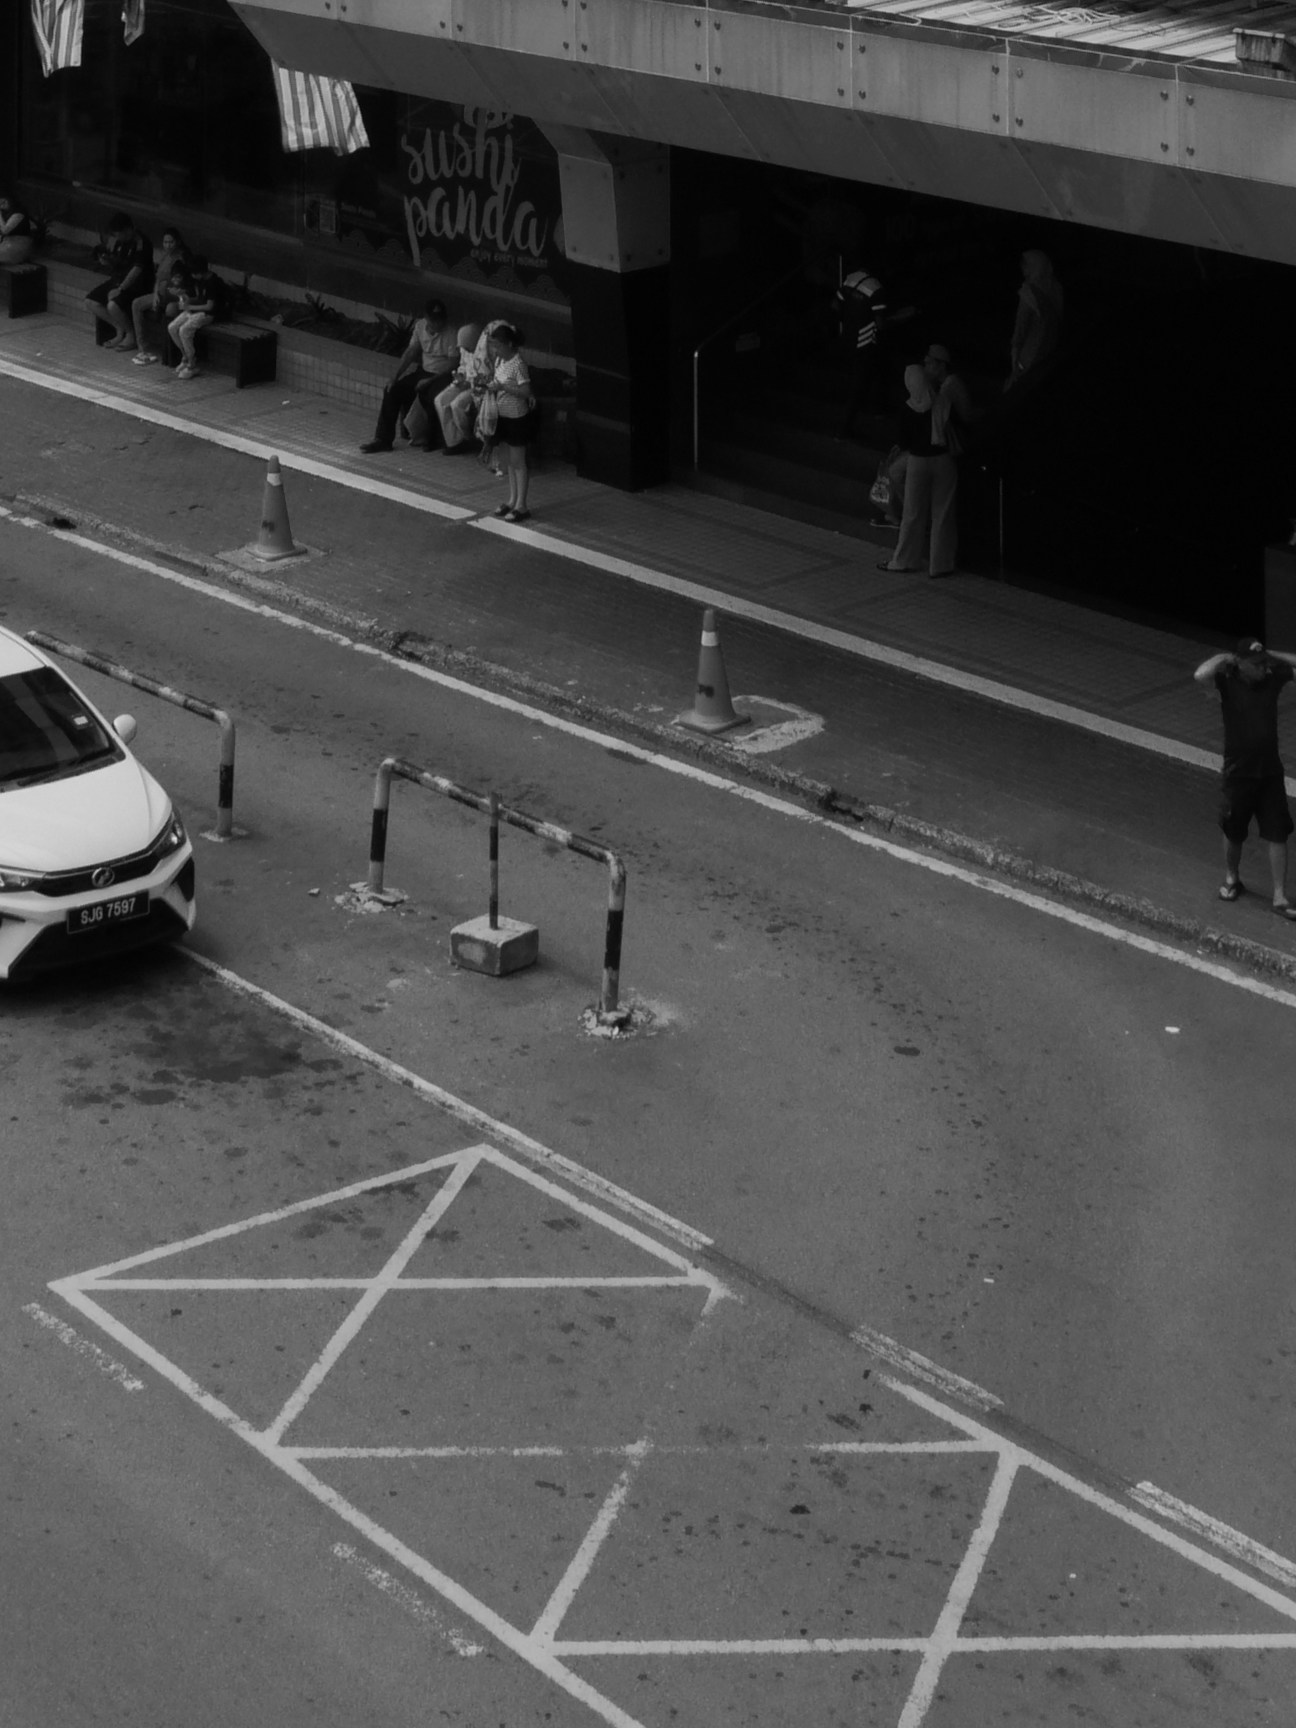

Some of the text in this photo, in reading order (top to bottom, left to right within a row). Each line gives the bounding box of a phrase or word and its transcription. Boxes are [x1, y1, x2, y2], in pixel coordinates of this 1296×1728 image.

[401, 108, 517, 185] sushi
[403, 178, 548, 267] panda
[80, 897, 137, 925] SJG 7597
